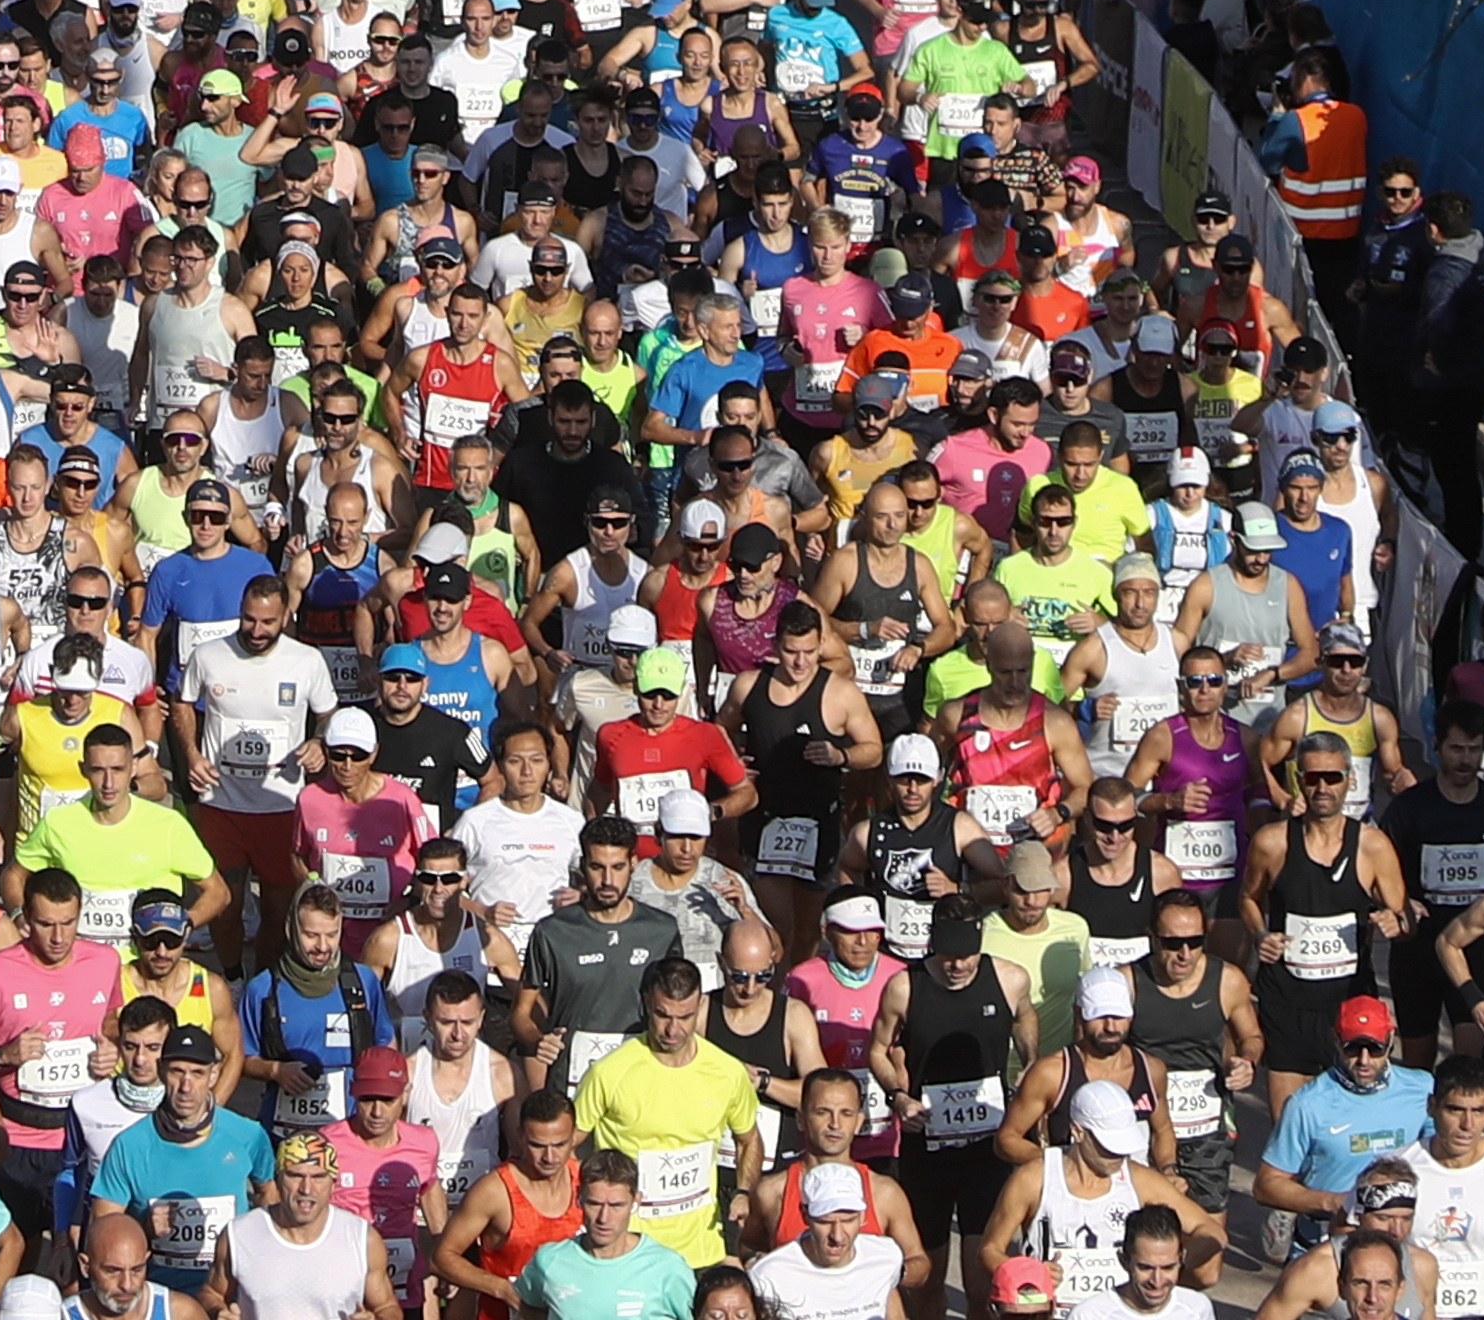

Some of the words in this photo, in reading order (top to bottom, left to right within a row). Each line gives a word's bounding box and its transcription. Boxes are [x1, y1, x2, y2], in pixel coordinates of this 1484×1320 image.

[466, 100, 493, 110] 2272
[165, 387, 196, 398] 1272
[439, 416, 473, 431] 2253
[1133, 431, 1166, 443] 2392
[250, 483, 268, 496] 16
[9, 568, 43, 587] 575
[333, 666, 358, 680] 168
[1129, 719, 1157, 732] 202
[235, 741, 272, 755] 1591
[637, 798, 656, 812] 19
[983, 808, 1021, 822] 1416
[1182, 843, 1222, 858] 1600
[1437, 866, 1477, 881] 1995
[335, 878, 376, 893] 2404
[83, 912, 125, 927] 1993
[899, 922, 932, 936] 233
[1300, 940, 1342, 954] 2369
[37, 1063, 80, 1081] 1573
[290, 1099, 330, 1115] 1852
[1168, 1095, 1207, 1111] 1298
[942, 1106, 987, 1124] 1419
[658, 1169, 700, 1189] 1467
[170, 1226, 218, 1241] 2085
[1069, 1275, 1116, 1291] 1320
